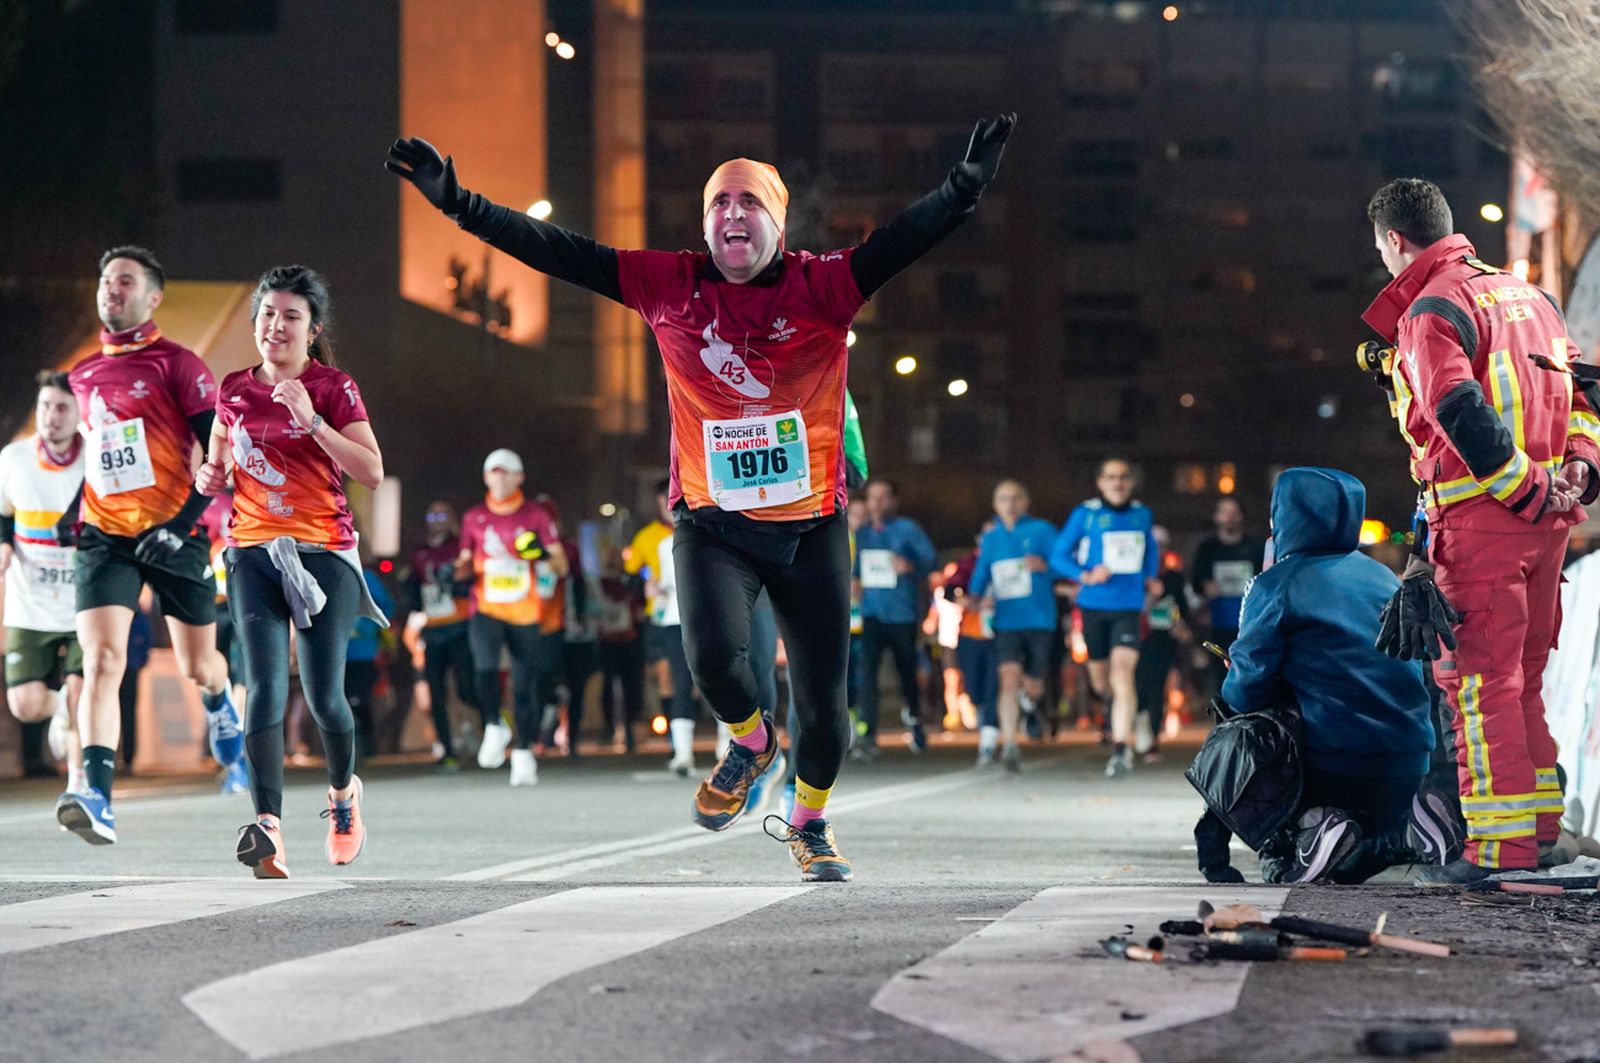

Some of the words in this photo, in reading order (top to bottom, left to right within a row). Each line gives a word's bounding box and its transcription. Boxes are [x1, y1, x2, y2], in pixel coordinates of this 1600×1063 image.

[720, 362, 745, 385] 43
[725, 428, 754, 439] NOCHE
[756, 427, 767, 436] DE
[715, 441, 734, 451] SAN
[736, 438, 769, 450] ANTÓN
[101, 446, 136, 471] 993
[246, 455, 266, 476] 43
[727, 447, 788, 479] 1976
